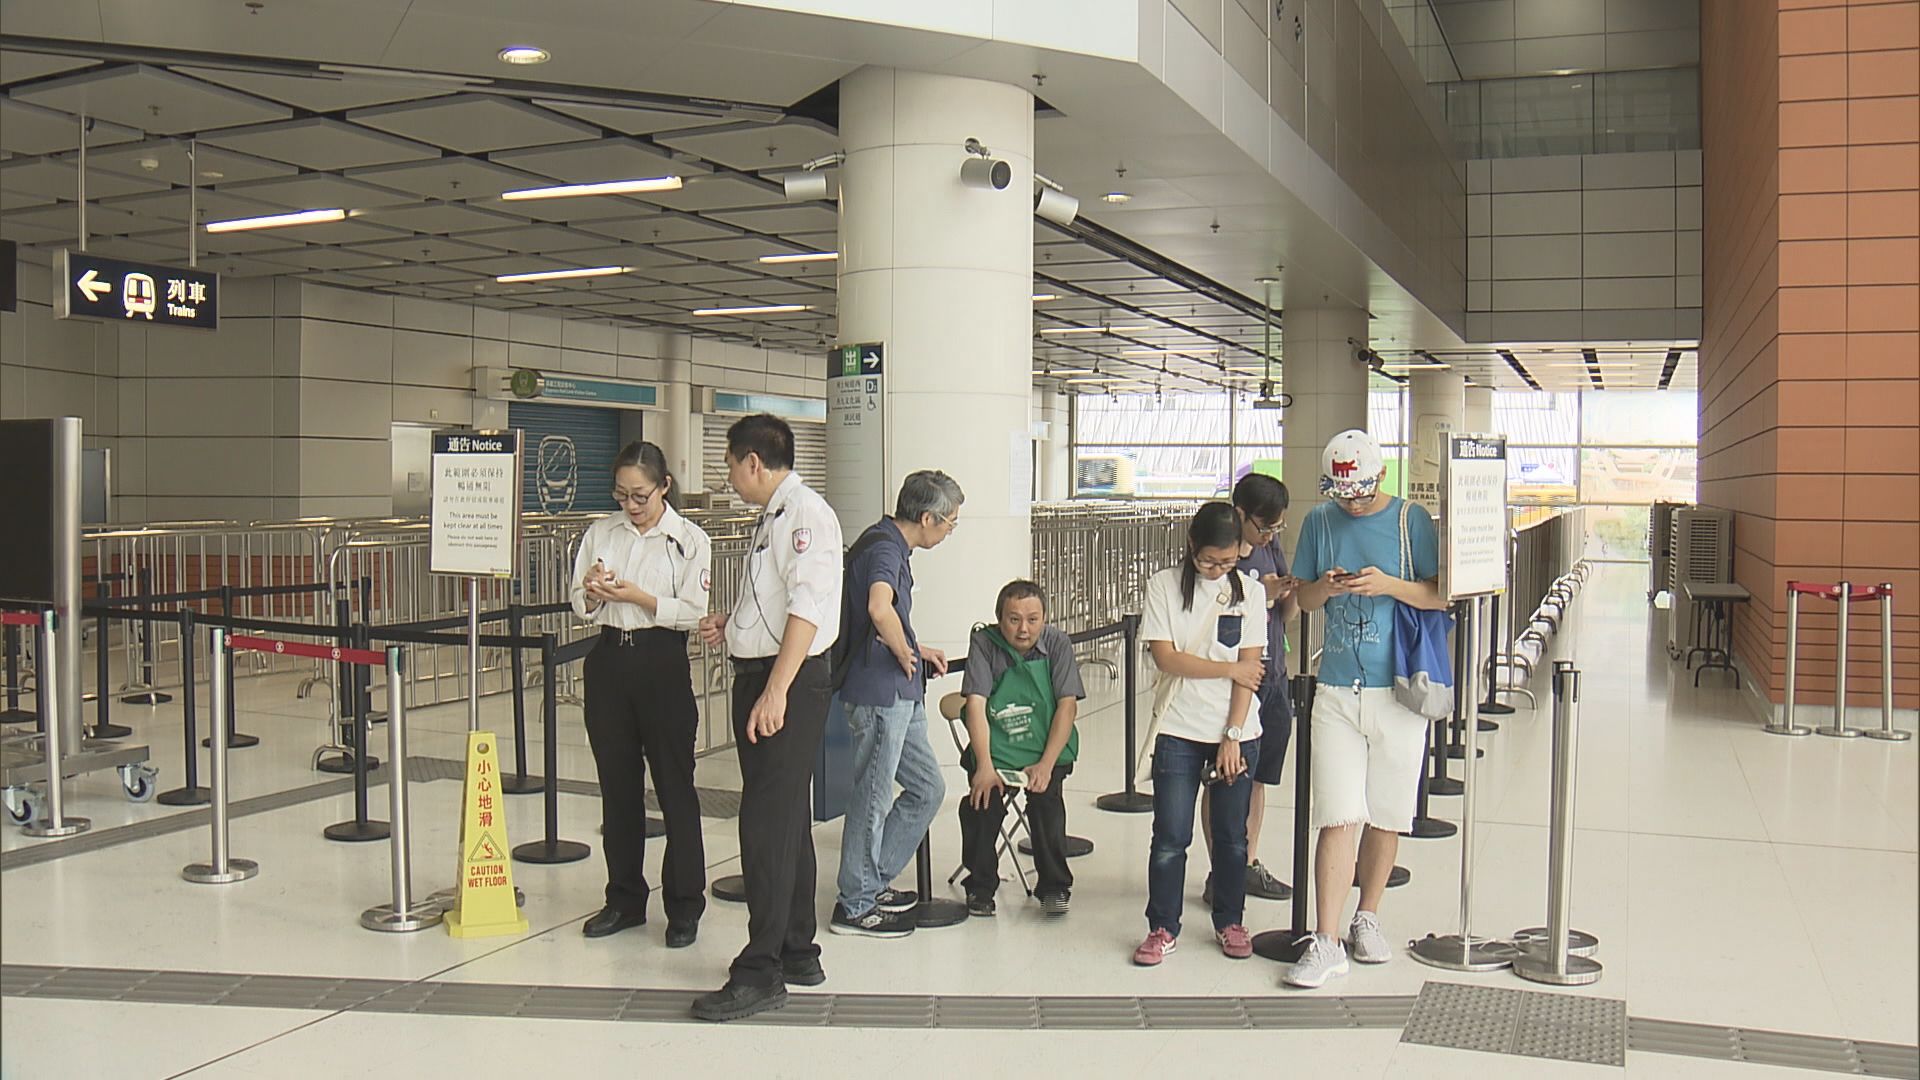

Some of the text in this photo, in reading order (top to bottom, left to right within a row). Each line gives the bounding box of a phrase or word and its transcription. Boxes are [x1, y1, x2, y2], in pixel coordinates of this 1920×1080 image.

[167, 279, 206, 305] 列車
[167, 303, 196, 318] Trains
[845, 350, 857, 367] 出
[447, 437, 503, 452] 通告 Notice
[1459, 441, 1498, 457] 通告 Notice
[449, 511, 461, 519] This
[443, 521, 457, 530] kept
[457, 521, 472, 529] clear
[487, 522, 503, 530] times
[477, 759, 493, 828] 小心地滑
[470, 864, 504, 876] CAUTION
[467, 876, 508, 888] WET FLOOR
